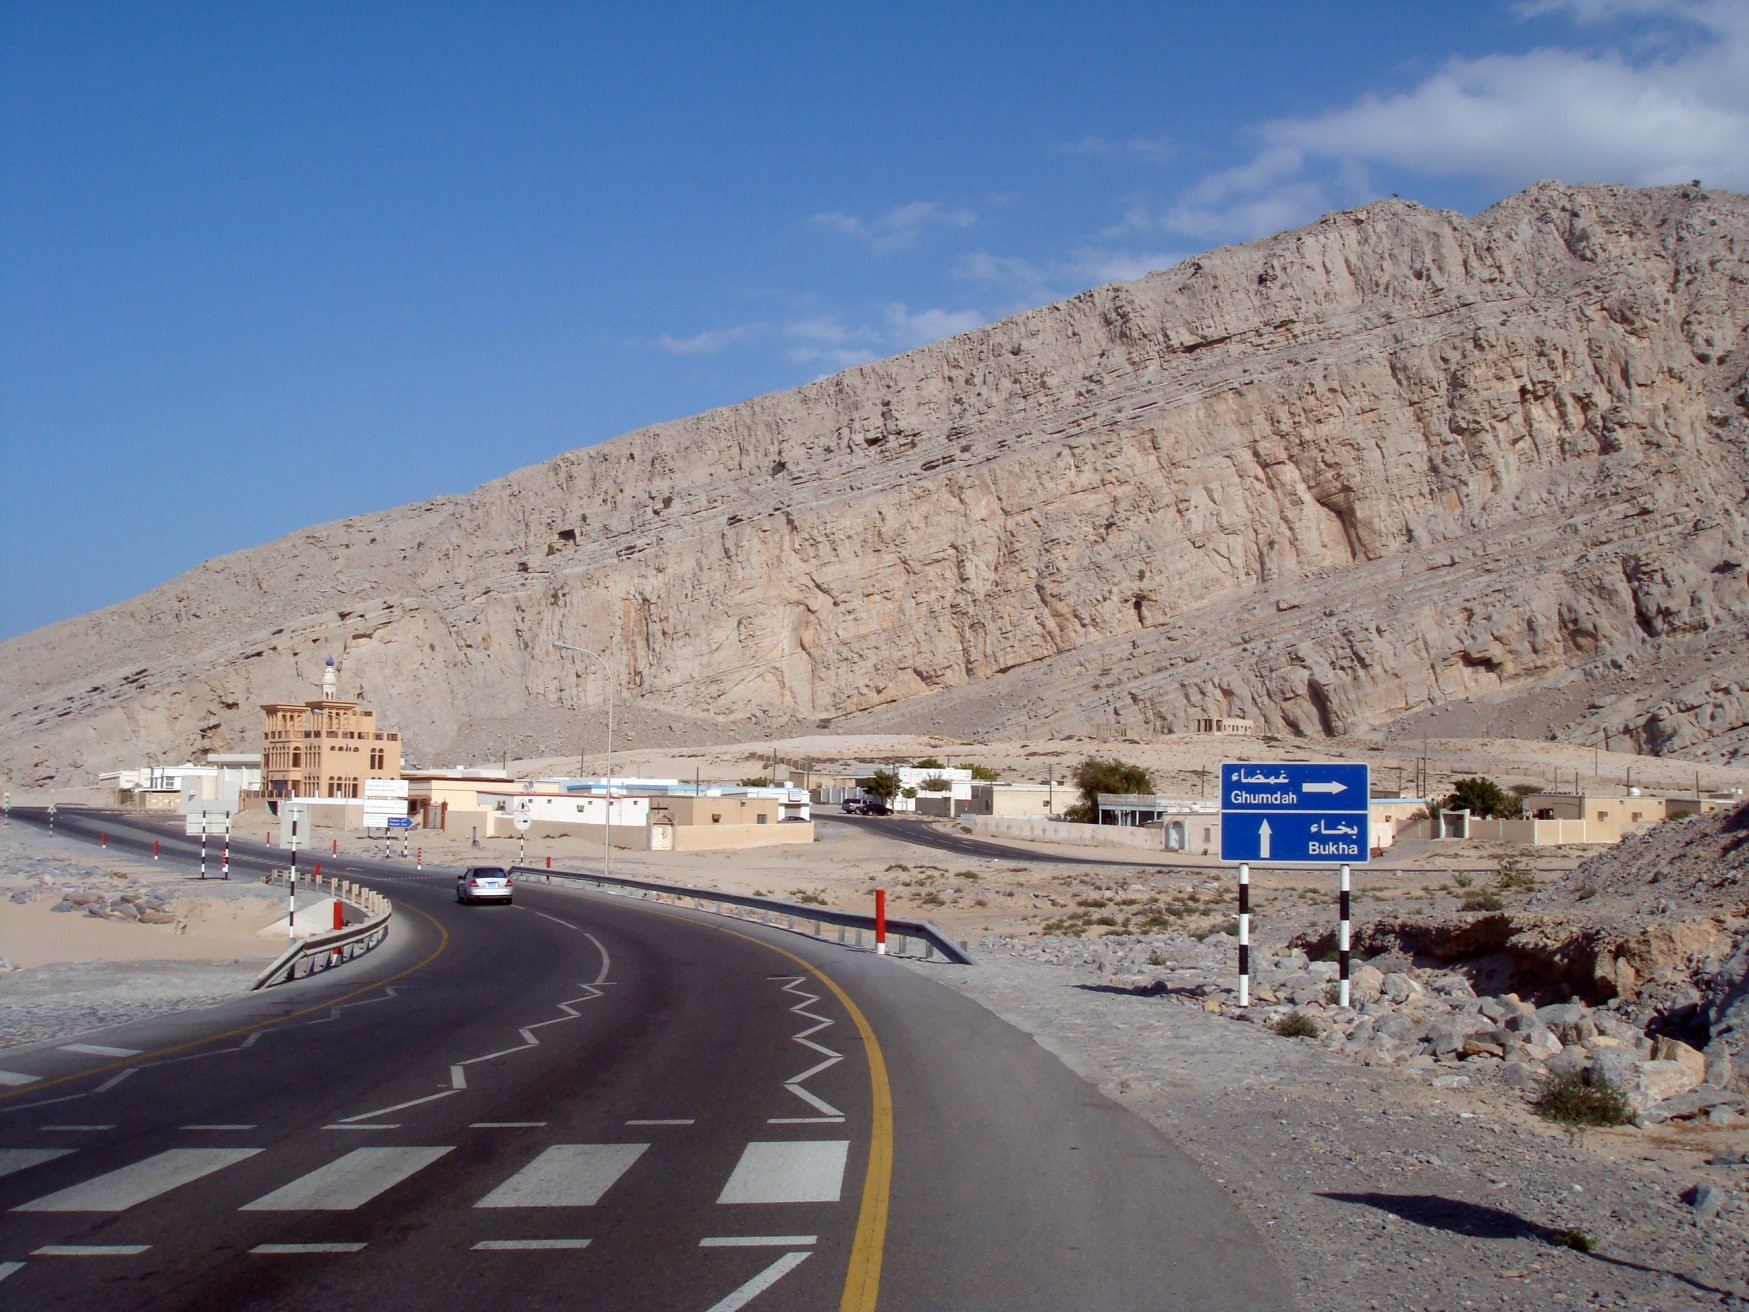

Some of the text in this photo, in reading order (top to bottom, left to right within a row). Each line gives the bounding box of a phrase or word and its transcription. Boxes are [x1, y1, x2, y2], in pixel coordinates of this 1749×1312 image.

[1231, 790, 1297, 804] Ghumdah
[1310, 819, 1358, 839] بخاء
[1309, 841, 1358, 855] Bukha
